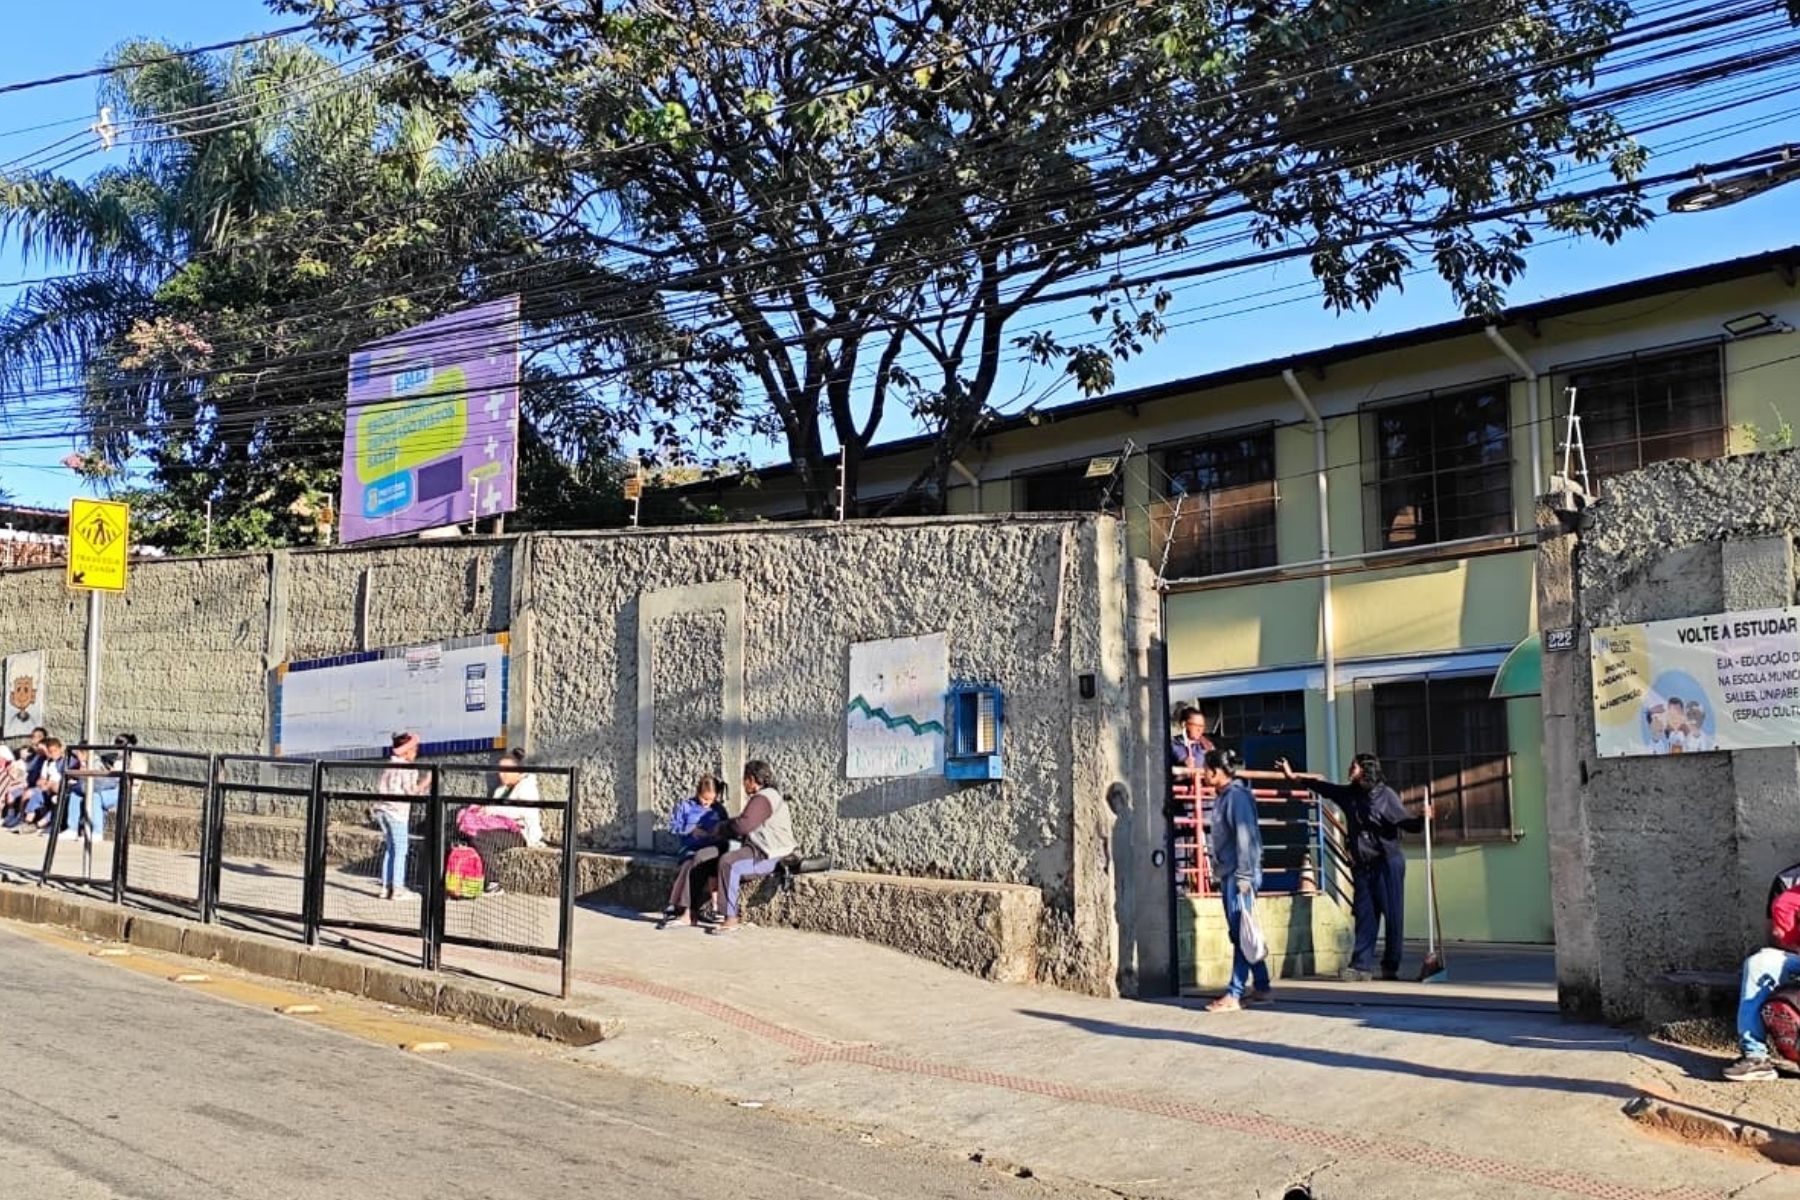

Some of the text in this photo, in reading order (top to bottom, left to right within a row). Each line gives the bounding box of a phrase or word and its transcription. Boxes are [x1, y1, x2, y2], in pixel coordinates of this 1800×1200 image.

[79, 563, 116, 573] ELEVADA
[1678, 617, 1797, 644] VOLTE A ESTUDAR
[1717, 658, 1733, 669] EJA
[1741, 651, 1790, 667] EDUCAÇÃO
[1718, 675, 1731, 686] NA
[1733, 673, 1766, 685] ESCOLA
[1733, 706, 1770, 722] (ESPAÇO
